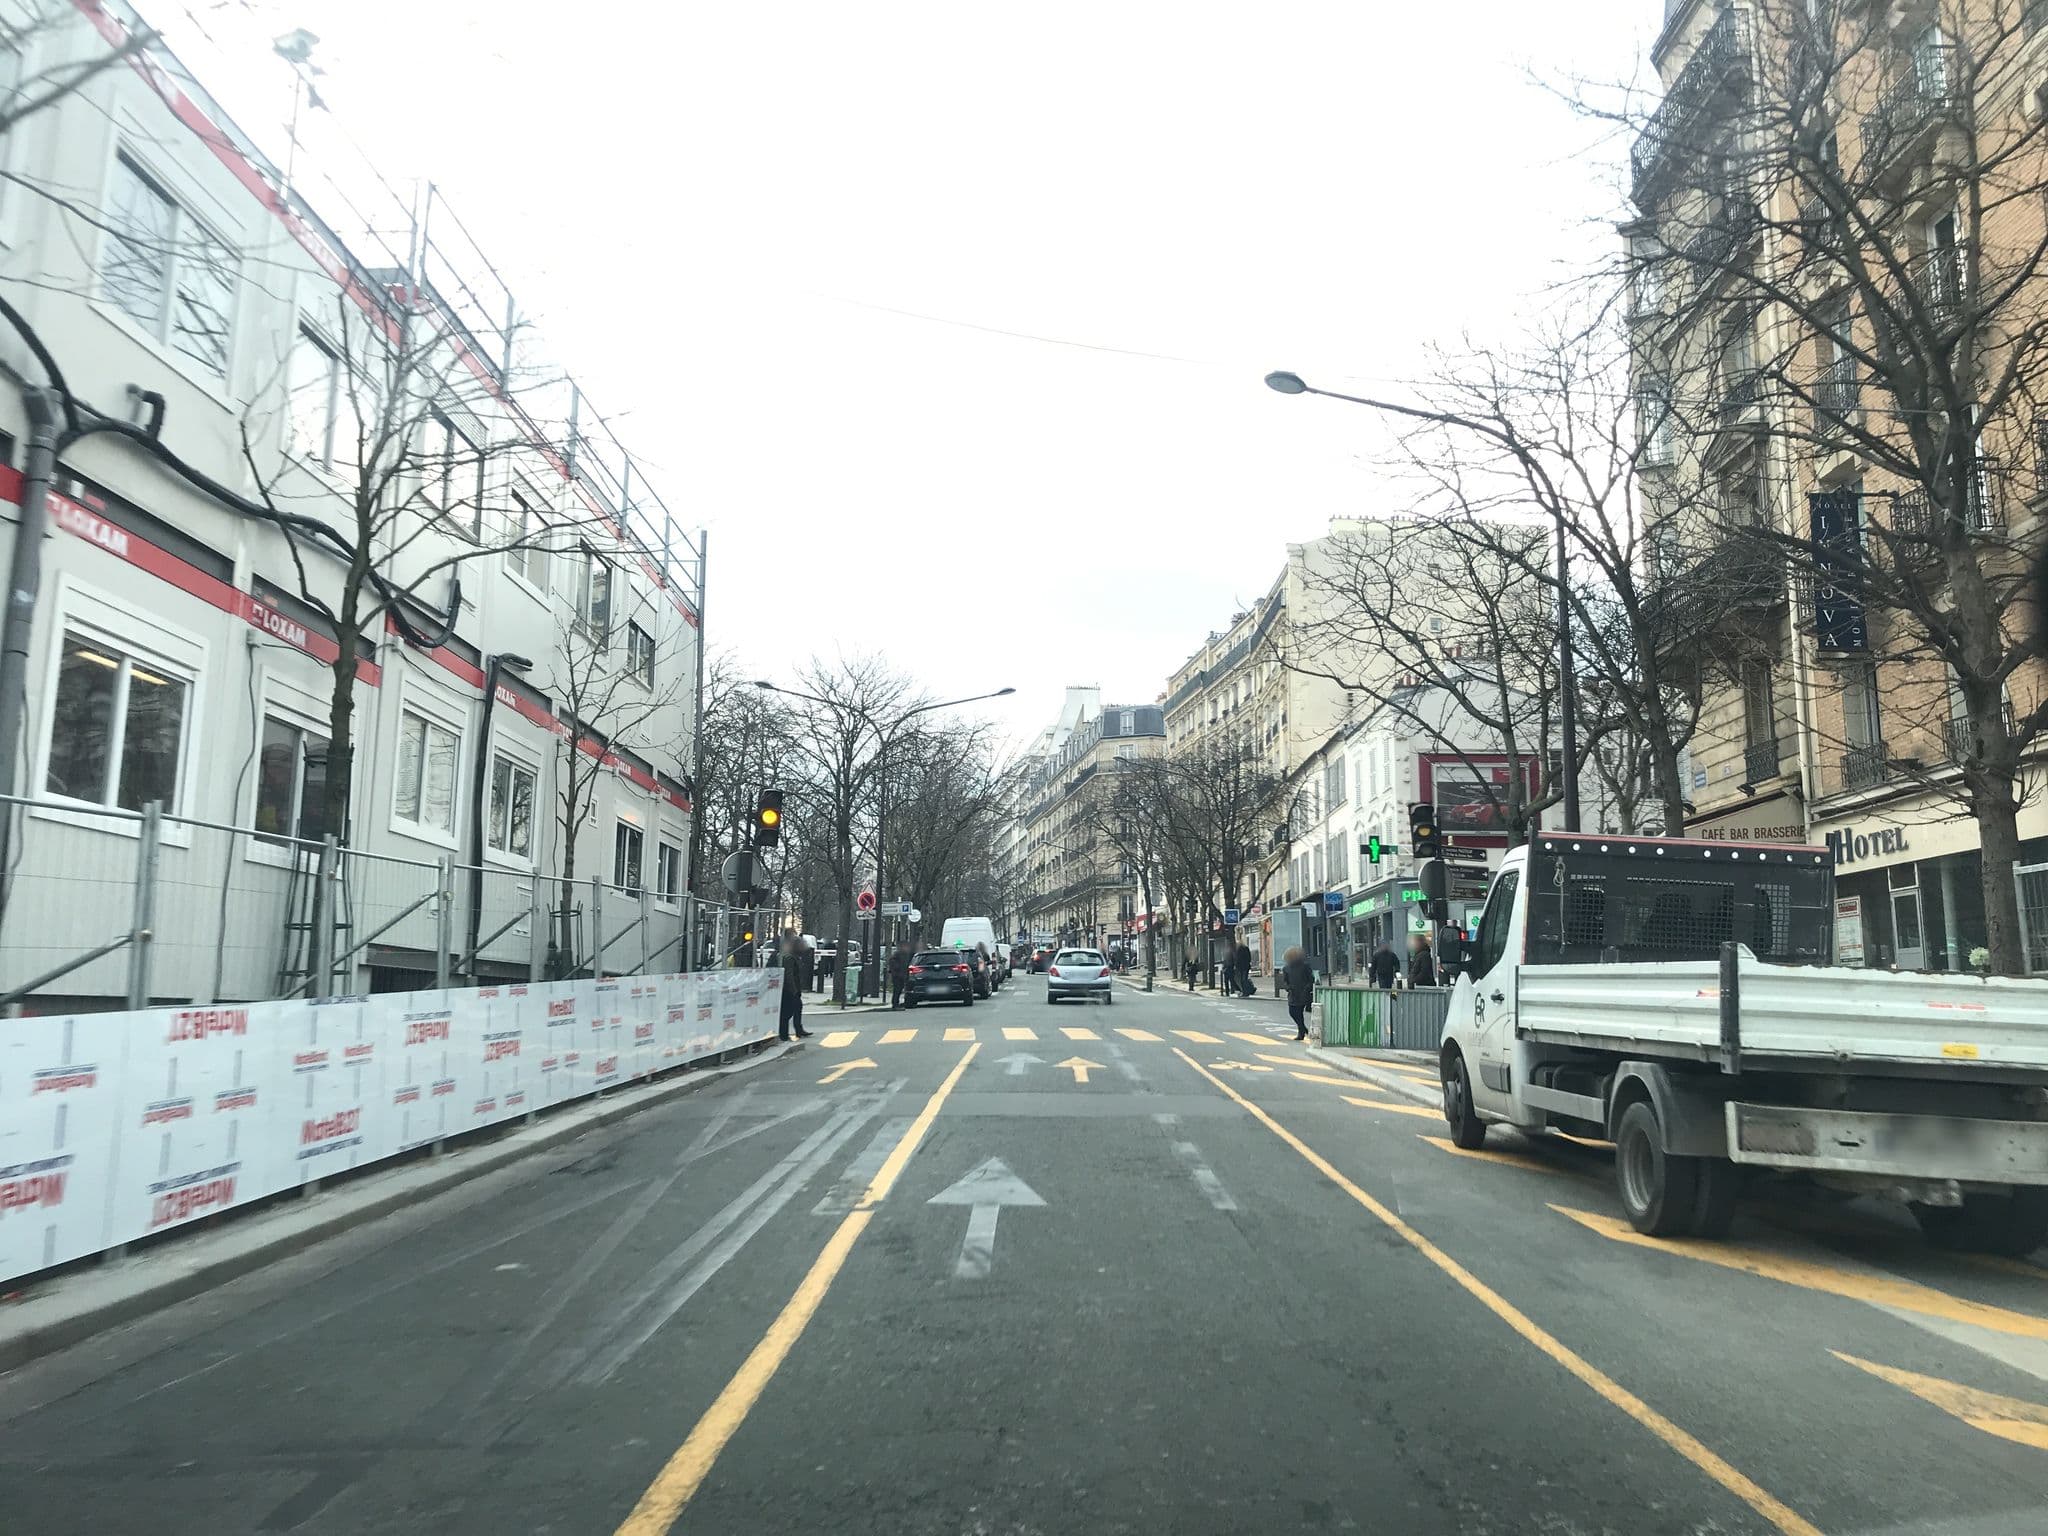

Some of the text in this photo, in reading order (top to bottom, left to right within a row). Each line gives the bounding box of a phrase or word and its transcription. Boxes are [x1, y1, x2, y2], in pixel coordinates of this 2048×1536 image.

[263, 609, 306, 647] LOXAM
[1702, 824, 1805, 840] CAFÉ BAR BRASSERIE
